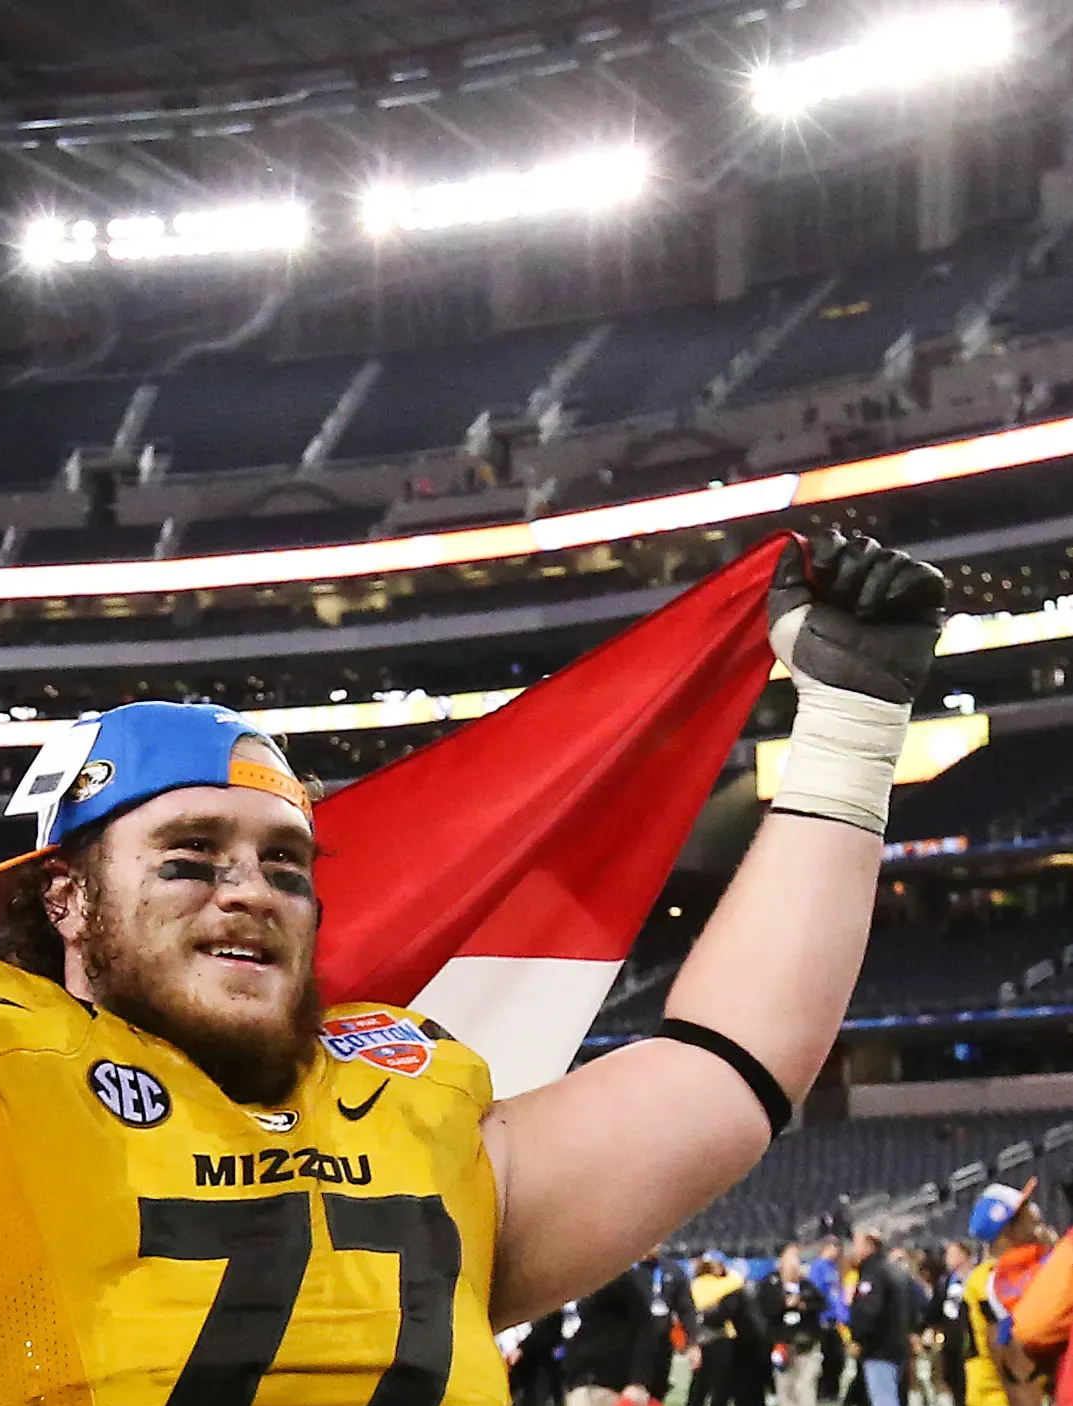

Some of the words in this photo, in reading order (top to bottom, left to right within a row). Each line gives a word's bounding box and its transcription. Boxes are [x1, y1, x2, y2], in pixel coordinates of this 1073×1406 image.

[328, 1022, 425, 1056] COTTON
[93, 1061, 165, 1122] SEC
[192, 1149, 372, 1187] MIZZOU
